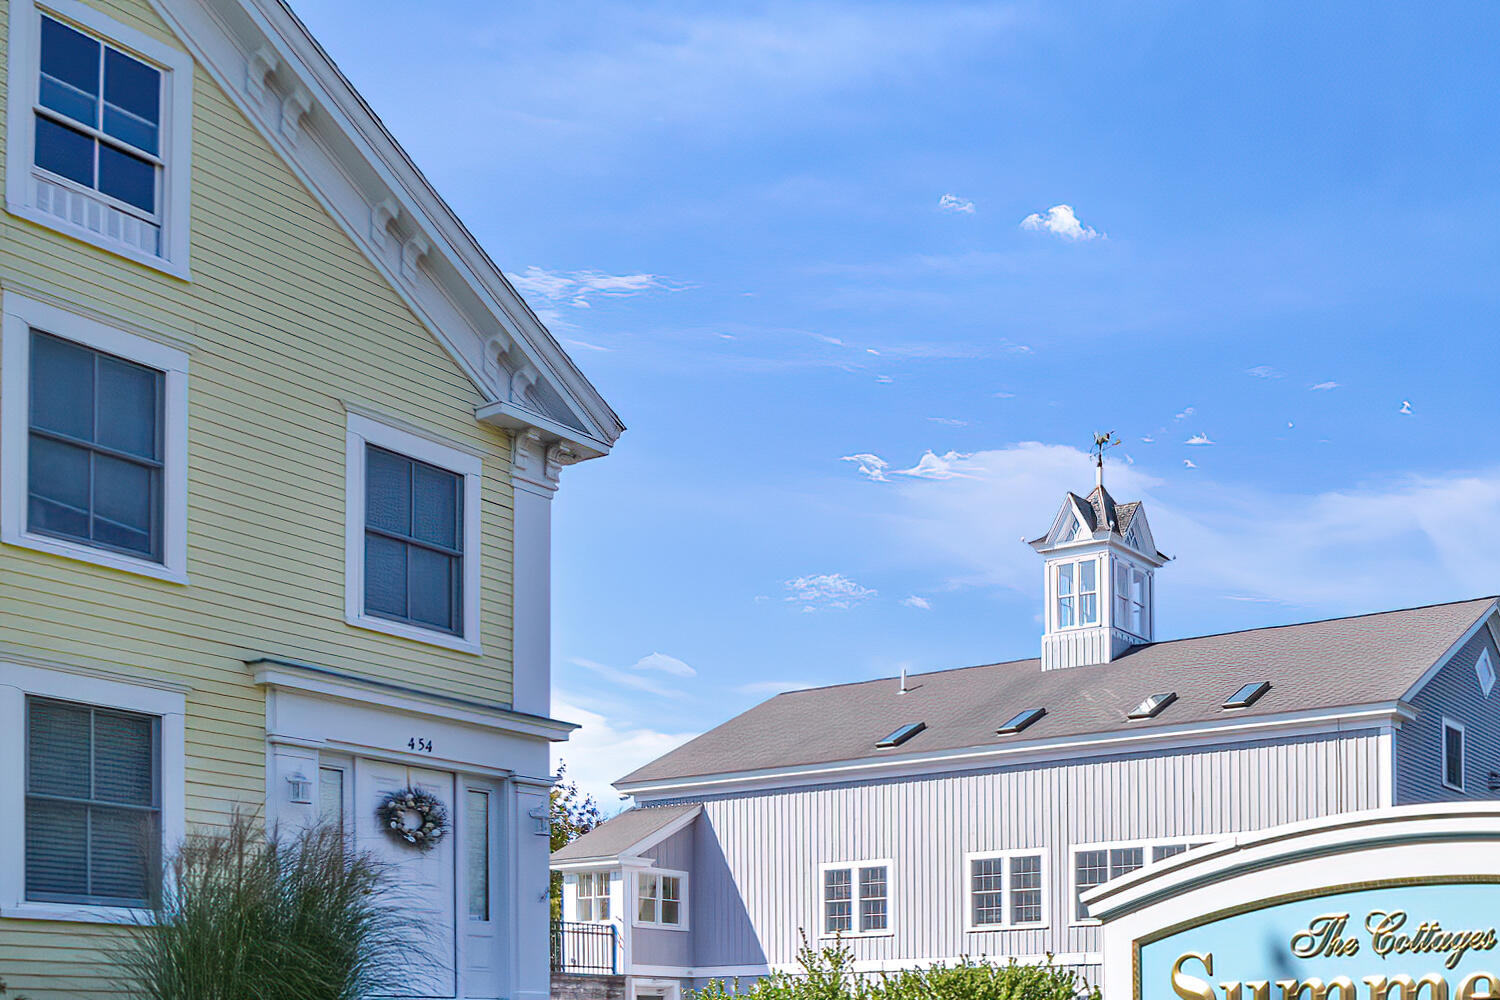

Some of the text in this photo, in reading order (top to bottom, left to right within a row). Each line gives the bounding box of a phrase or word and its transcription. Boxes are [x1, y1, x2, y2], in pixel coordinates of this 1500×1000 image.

[408, 737, 433, 753] 454
[1290, 913, 1360, 959] The
[1365, 909, 1499, 970] Cottages
